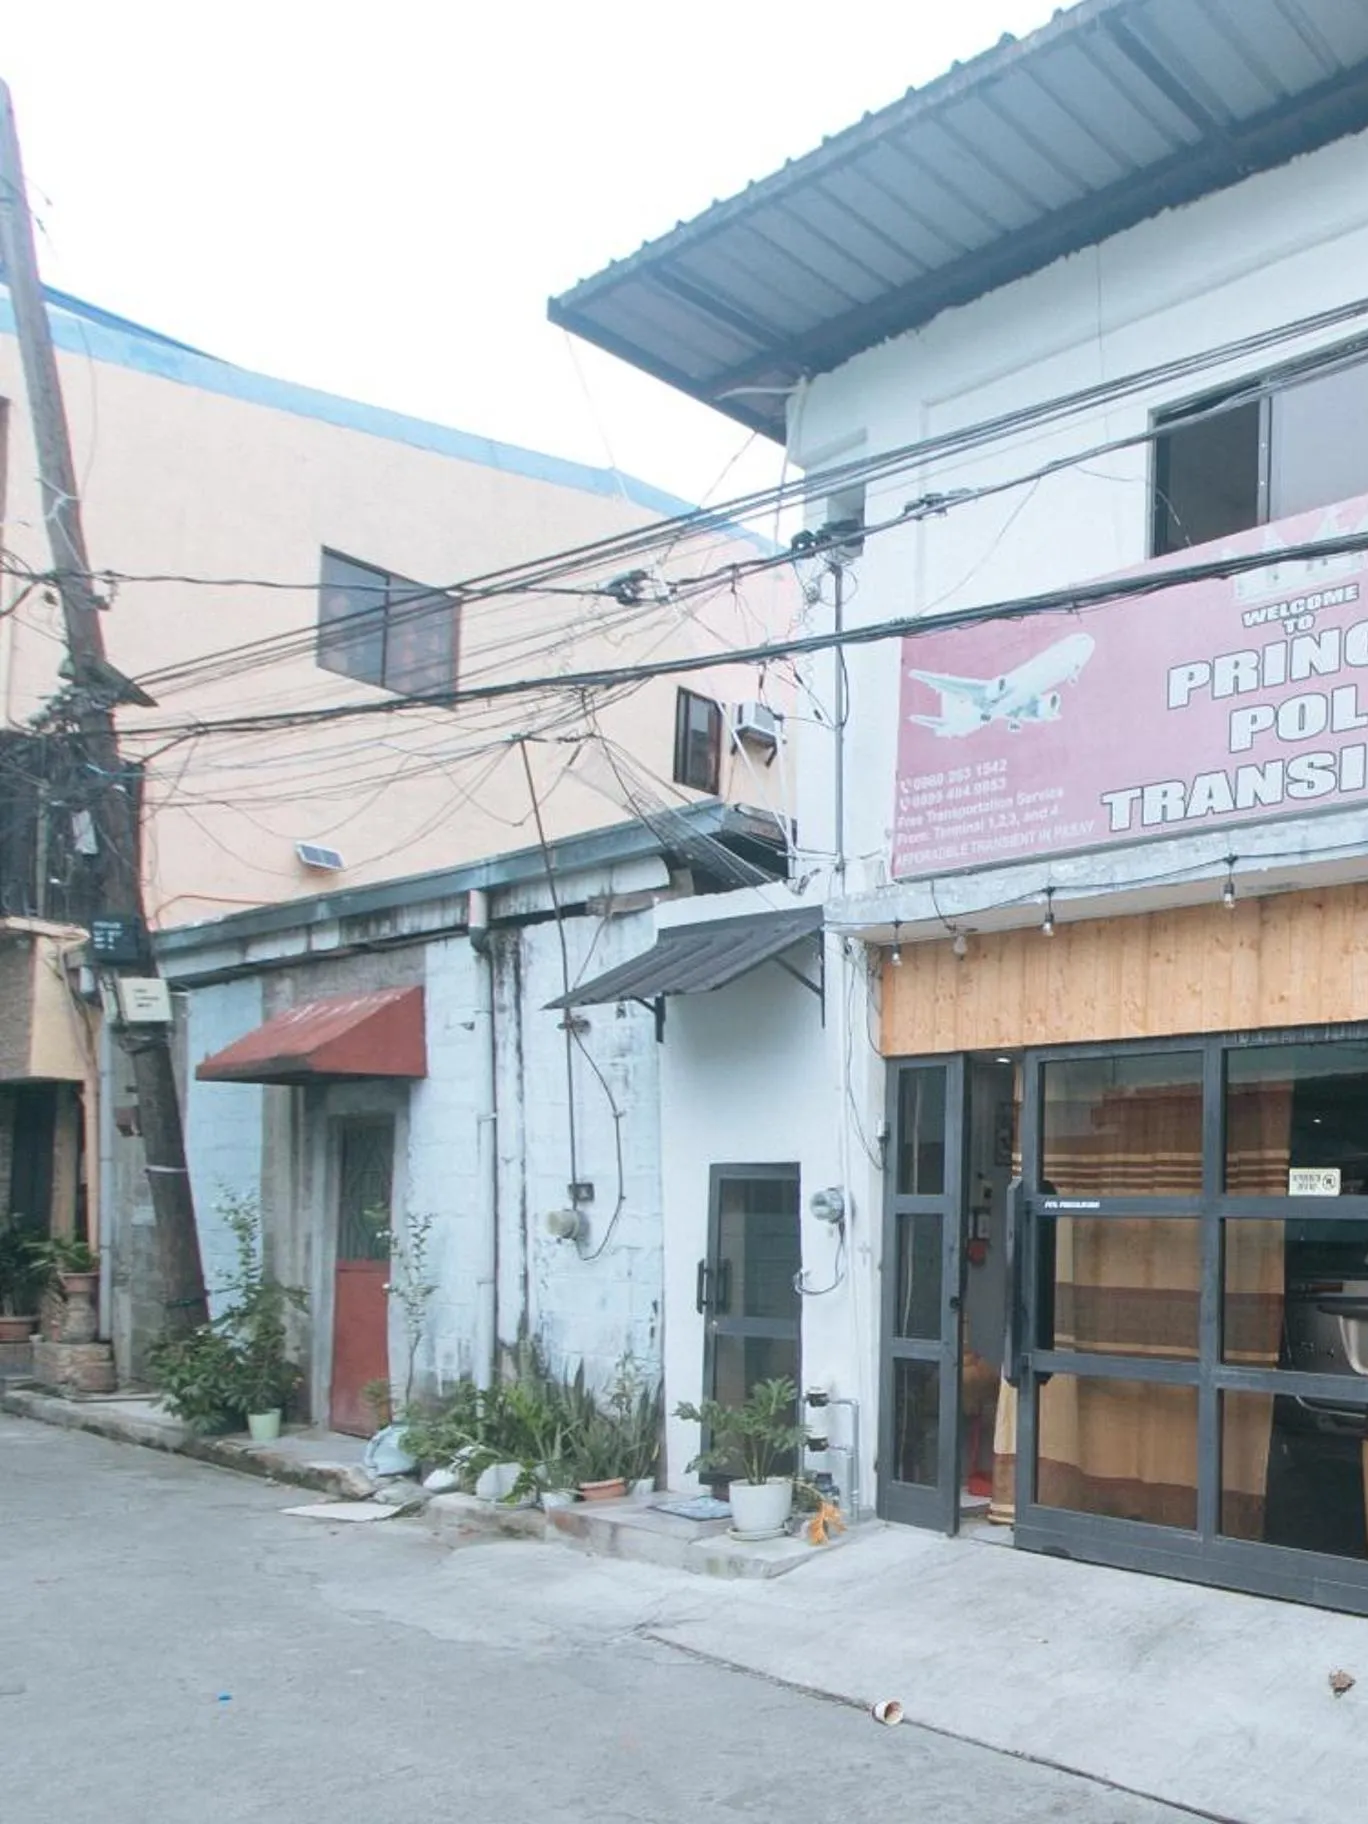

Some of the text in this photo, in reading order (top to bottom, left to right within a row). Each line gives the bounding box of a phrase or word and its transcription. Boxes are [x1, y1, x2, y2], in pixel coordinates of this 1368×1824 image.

[1242, 583, 1359, 628] WELCOME
[1282, 613, 1315, 635] TO
[926, 797, 1014, 824] Transportation
[1016, 786, 1064, 807] Service
[934, 817, 985, 840] Terminal
[1023, 806, 1049, 823] and
[970, 829, 1034, 854] TRANSIENT
[1054, 819, 1095, 840] PASAY
